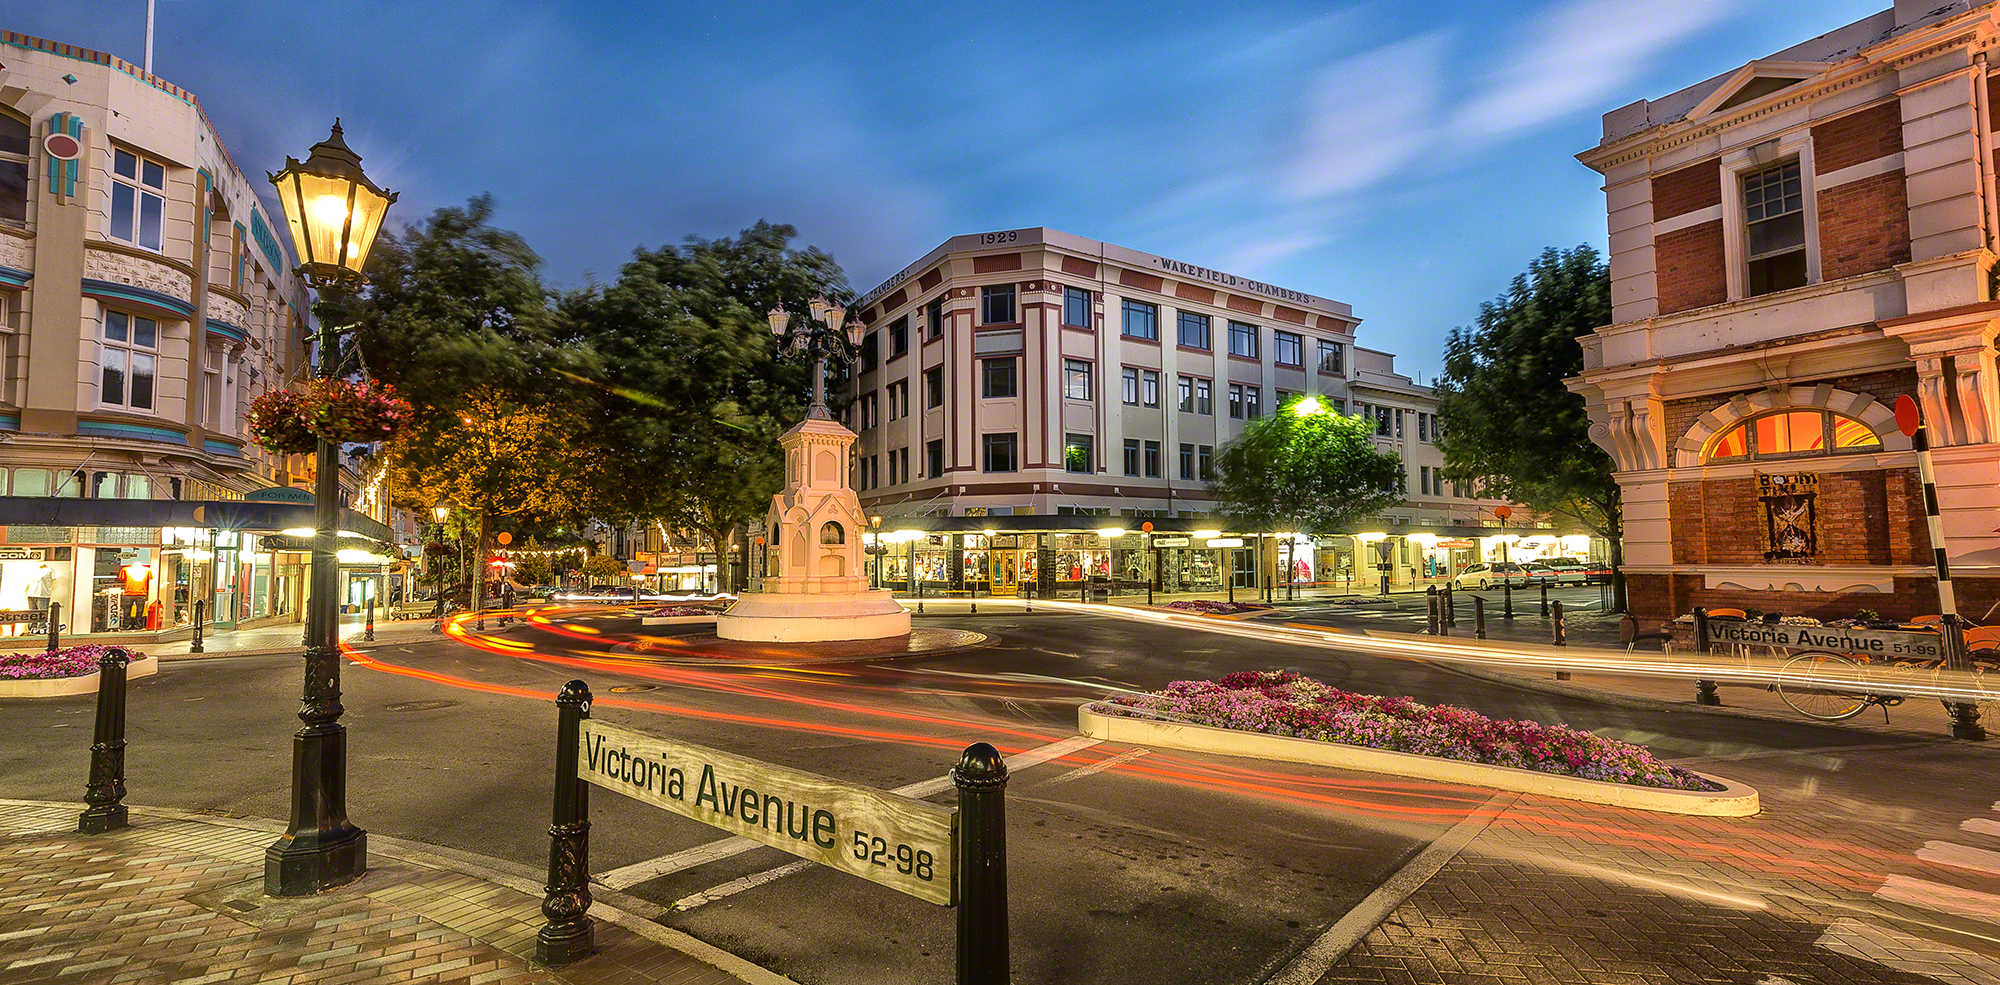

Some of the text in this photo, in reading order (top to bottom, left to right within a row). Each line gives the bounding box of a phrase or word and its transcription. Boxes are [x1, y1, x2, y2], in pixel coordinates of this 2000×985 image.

[979, 231, 1018, 246] 1929
[869, 269, 906, 301] CHAMBERS
[1160, 257, 1310, 304] WAKEFIELD CHAMBERS
[261, 491, 285, 499] FOR
[0, 612, 46, 621] Street
[1709, 623, 1937, 656] Victoria Avenue 51-99
[585, 731, 934, 882] Victoria Avenue 52-98
